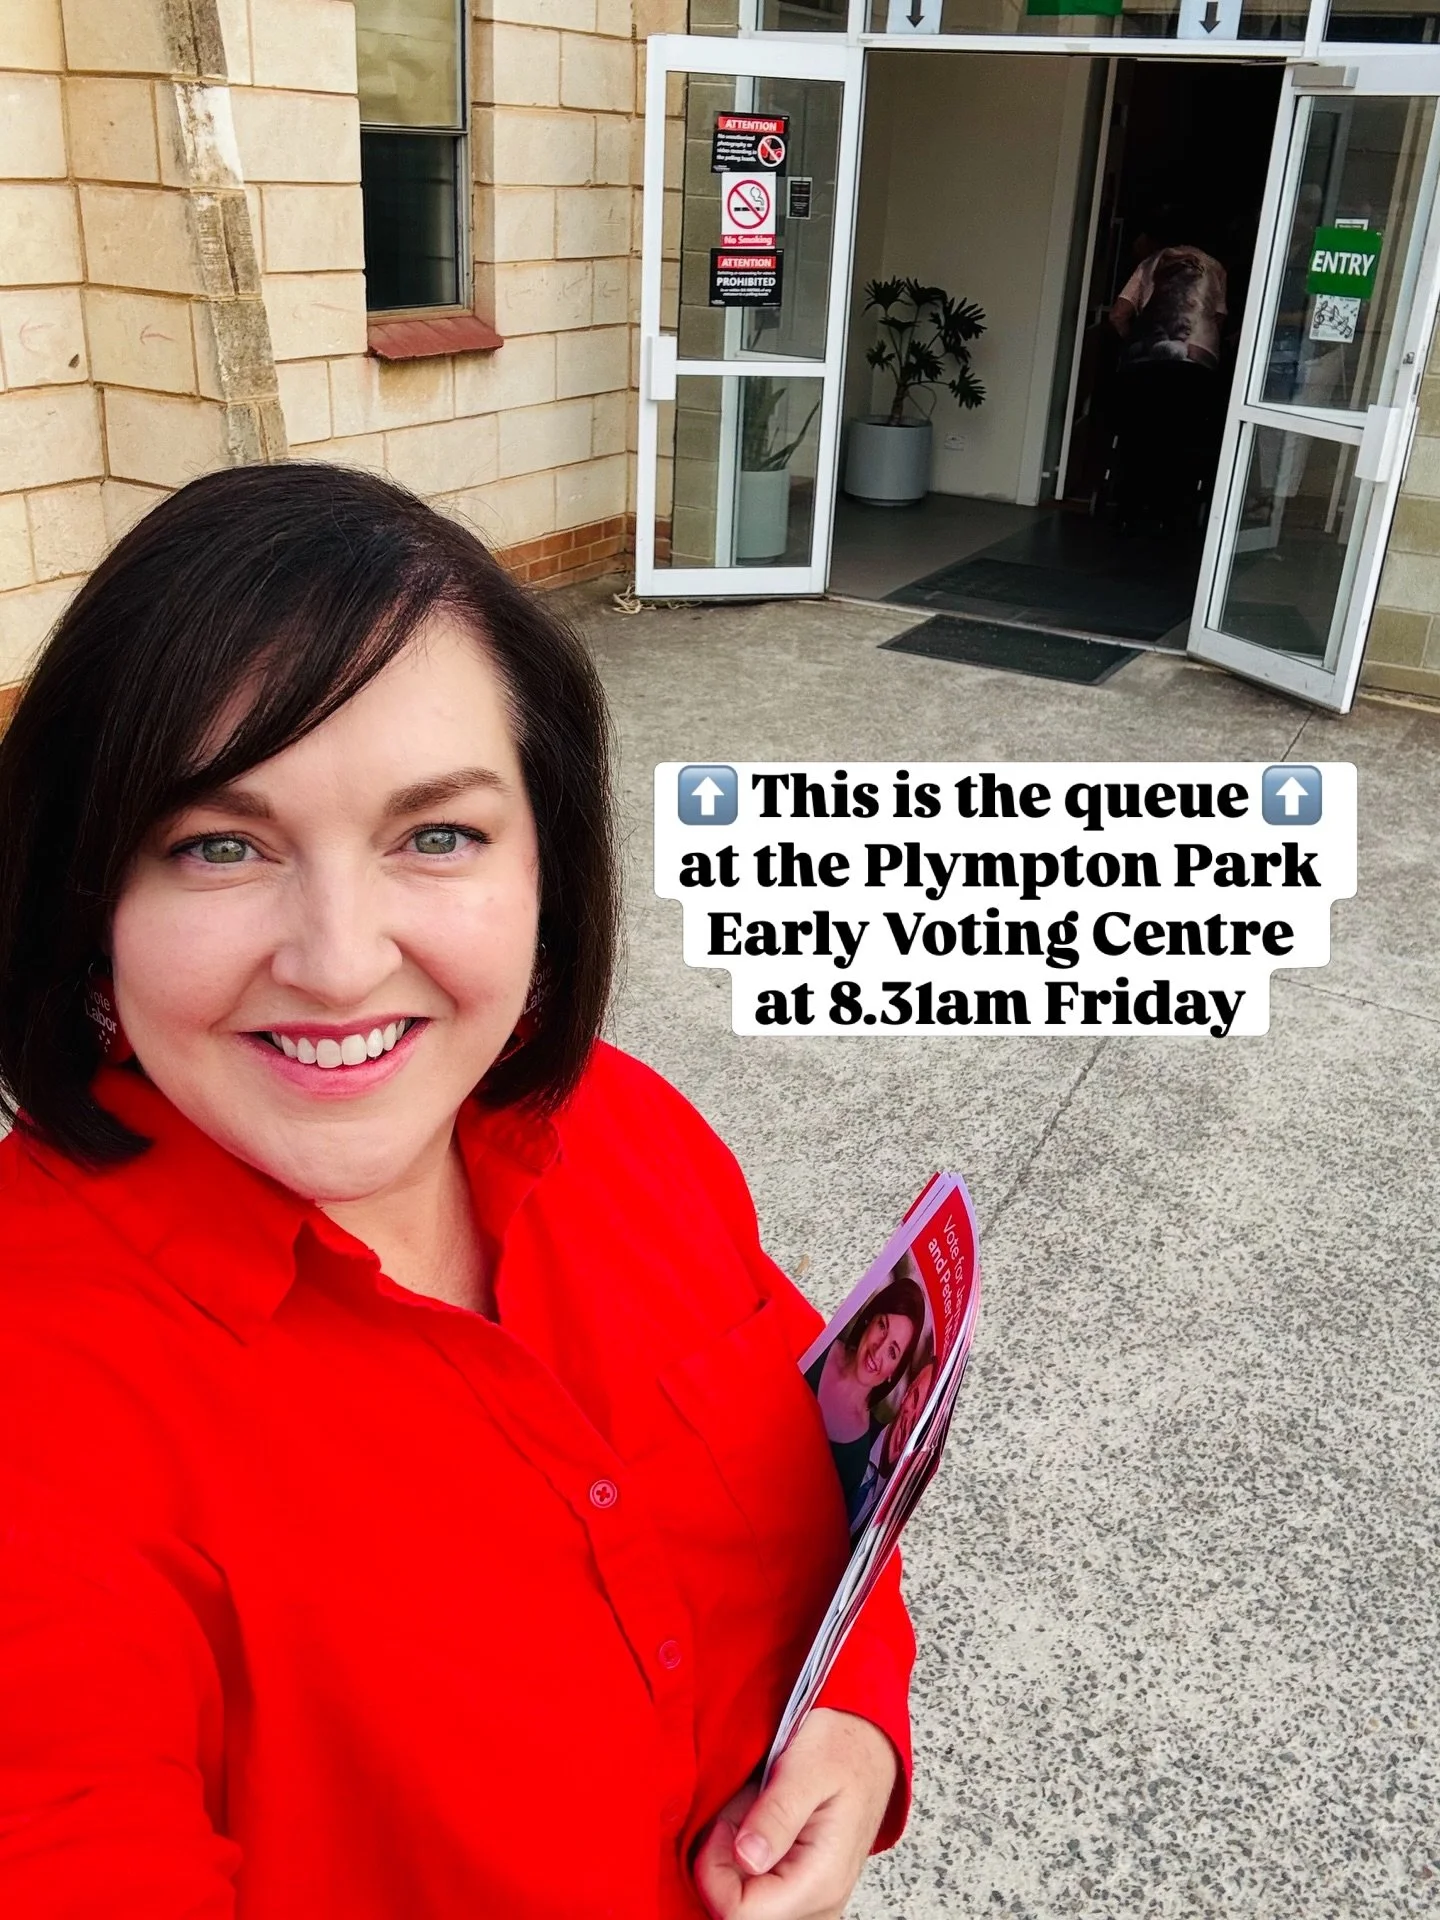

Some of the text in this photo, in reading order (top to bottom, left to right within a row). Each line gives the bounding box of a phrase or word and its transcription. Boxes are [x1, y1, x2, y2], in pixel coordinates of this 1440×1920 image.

[725, 119, 777, 131] ATTENTION
[724, 235, 773, 246] No Smoking
[721, 258, 772, 267] ATTENTION
[1311, 250, 1376, 277] ENTRY
[716, 277, 776, 287] PROHIBITED
[943, 1214, 960, 1261] Vote
[954, 1255, 965, 1285] for
[928, 1237, 947, 1275] and
[939, 1270, 953, 1319] Peter
